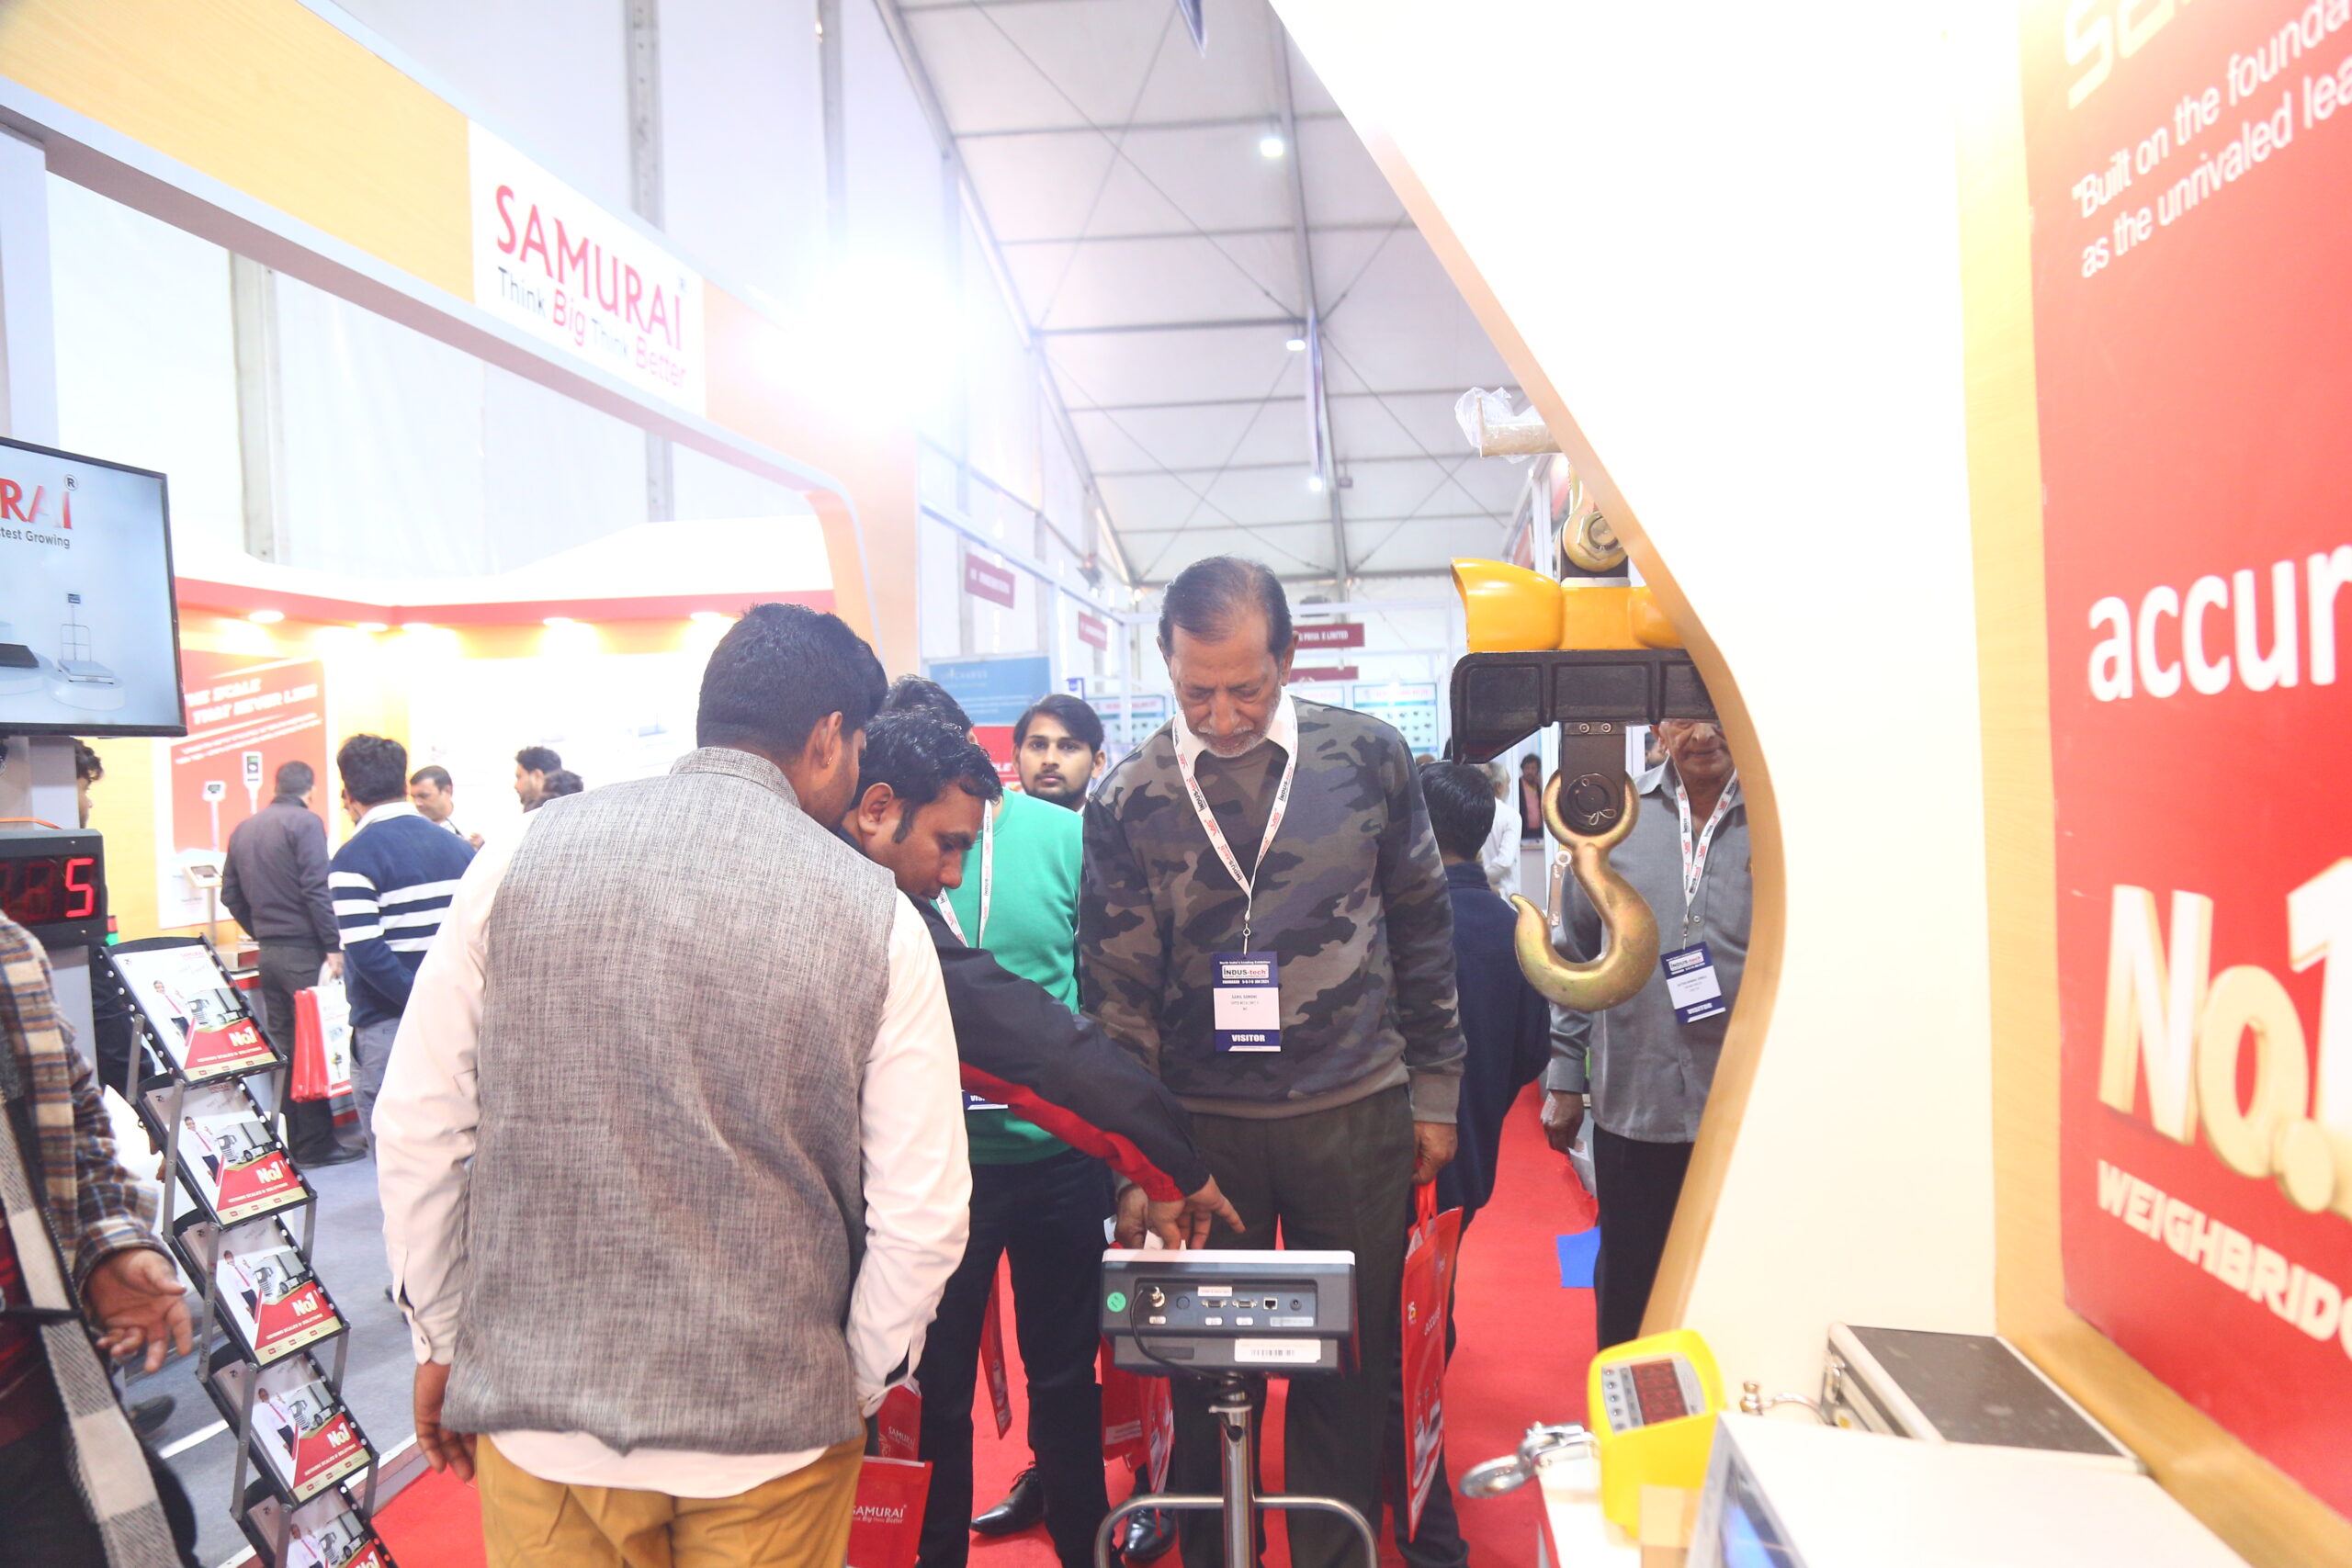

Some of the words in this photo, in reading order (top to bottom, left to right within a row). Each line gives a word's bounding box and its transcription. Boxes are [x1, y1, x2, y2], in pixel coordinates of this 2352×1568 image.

[2135, 127, 2169, 175] on
[2174, 86, 2221, 146] the
[2081, 236, 2109, 278] as
[2113, 207, 2153, 256] the
[2158, 90, 2293, 226] unrivaled
[496, 185, 682, 351] SAMURAI
[498, 265, 547, 318] Think
[552, 288, 586, 346] Big
[592, 317, 629, 358] Think
[636, 335, 687, 389] Better
[26, 530, 71, 549] Growing
[65, 857, 95, 918] 5
